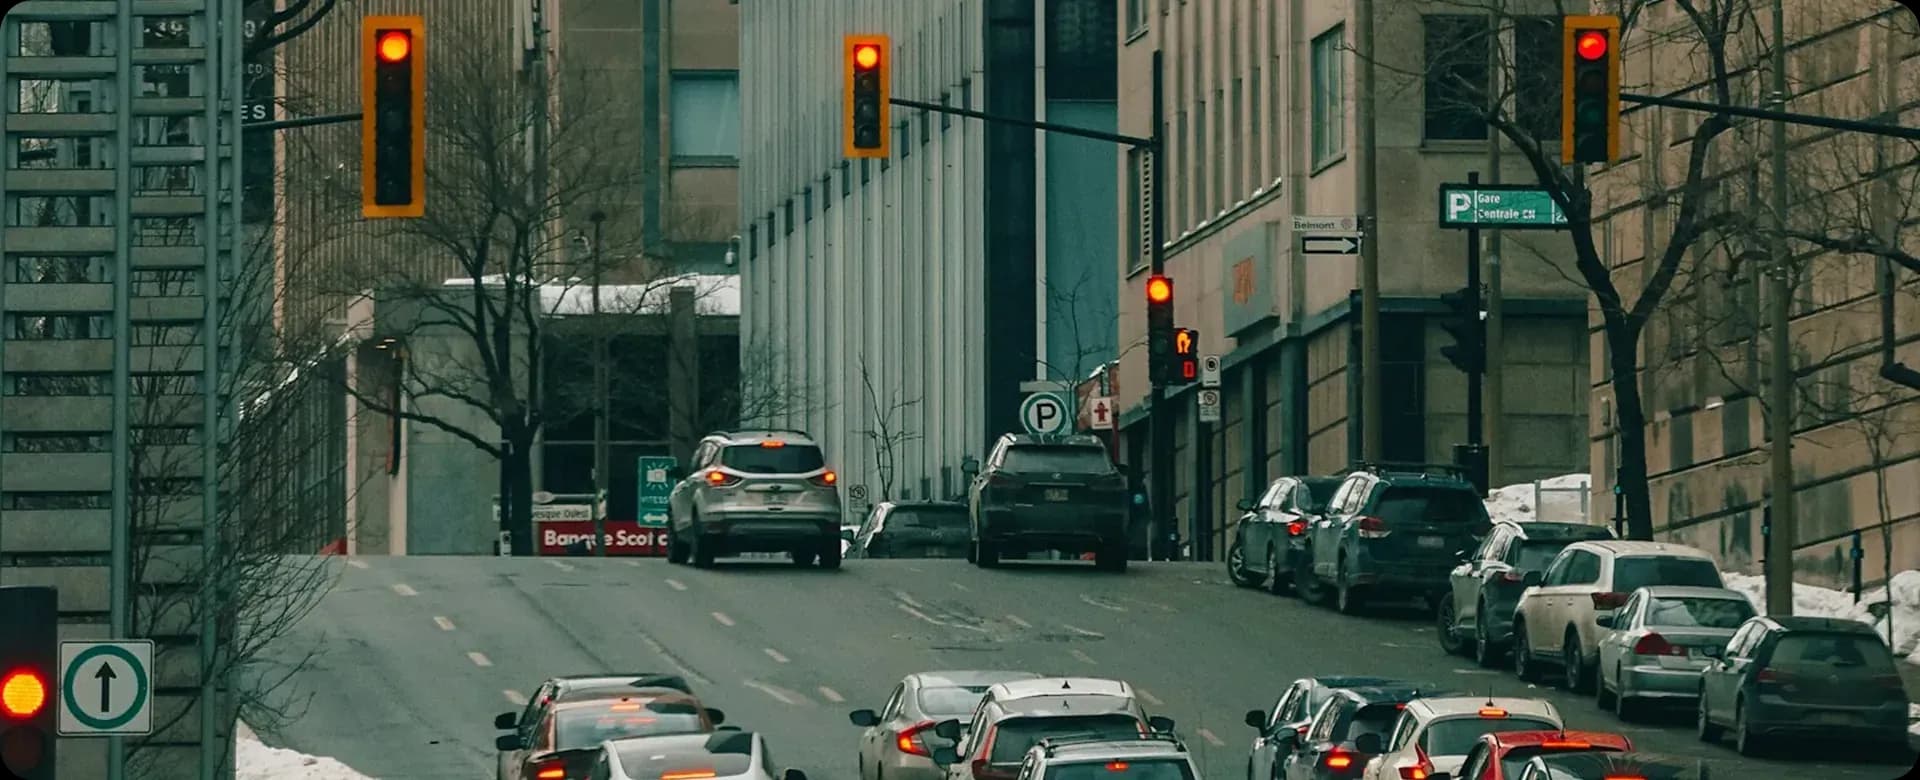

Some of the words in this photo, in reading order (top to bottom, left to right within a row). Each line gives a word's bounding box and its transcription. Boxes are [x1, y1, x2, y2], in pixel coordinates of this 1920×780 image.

[1478, 193, 1501, 204] Gare
[1449, 193, 1471, 220] P
[1478, 209, 1520, 220] Centrale
[1294, 221, 1335, 230] Belmont
[1036, 402, 1057, 430] P
